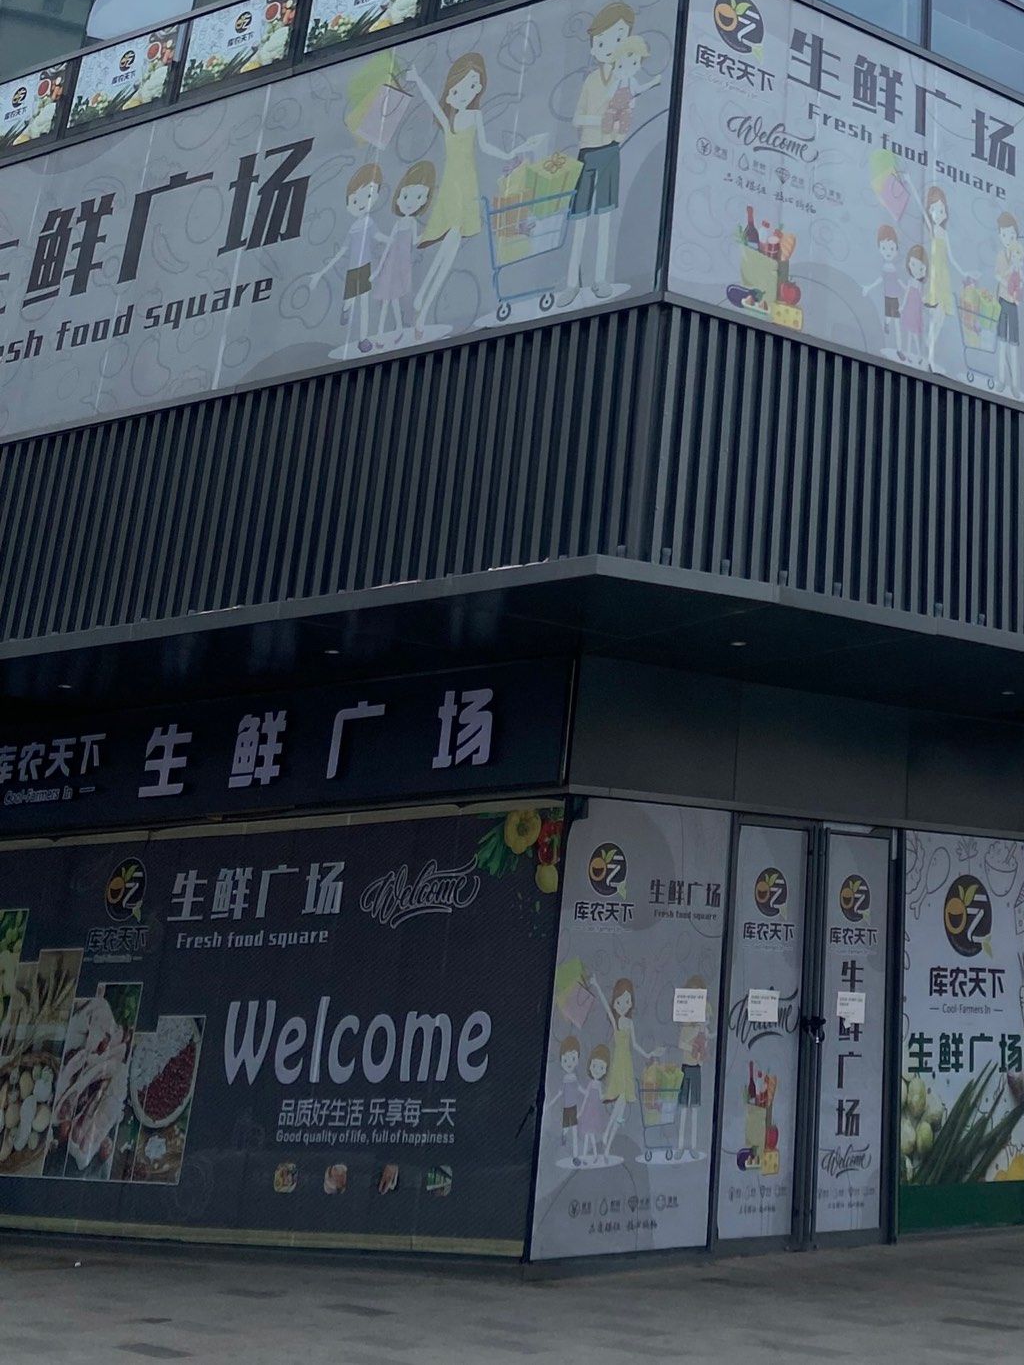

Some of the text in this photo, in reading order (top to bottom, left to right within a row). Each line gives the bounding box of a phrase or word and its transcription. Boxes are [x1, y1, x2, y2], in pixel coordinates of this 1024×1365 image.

[696, 43, 775, 92] 库农天下
[787, 27, 1016, 177] 生鲜广场
[726, 115, 819, 163] Welcome
[808, 102, 1006, 200] Fresh food square
[0, 137, 315, 315] 鲜广场
[56, 303, 135, 352] food
[143, 277, 273, 330] square
[138, 688, 494, 798] 生鲜广场
[167, 861, 345, 922] 生鲜广场
[359, 853, 481, 929] Welcome
[574, 901, 634, 923] 库农天下
[649, 878, 721, 908] 生鲜广场
[176, 928, 329, 949] Fresh food square
[743, 921, 795, 942] 库农天下
[830, 927, 877, 946] 库农天下
[929, 965, 1005, 999] 库农天下
[224, 995, 492, 1086] Welcome
[907, 1031, 1023, 1074] 生鲜广场
[278, 1098, 457, 1127] 品质好生活 乐享每一天
[276, 1130, 300, 1143] Good
[302, 1129, 336, 1146] quality
[339, 1129, 351, 1143] of
[371, 1129, 390, 1144] full
[389, 1129, 402, 1143] of
[402, 1129, 455, 1146] happiness
[820, 1143, 872, 1179] Welcome
